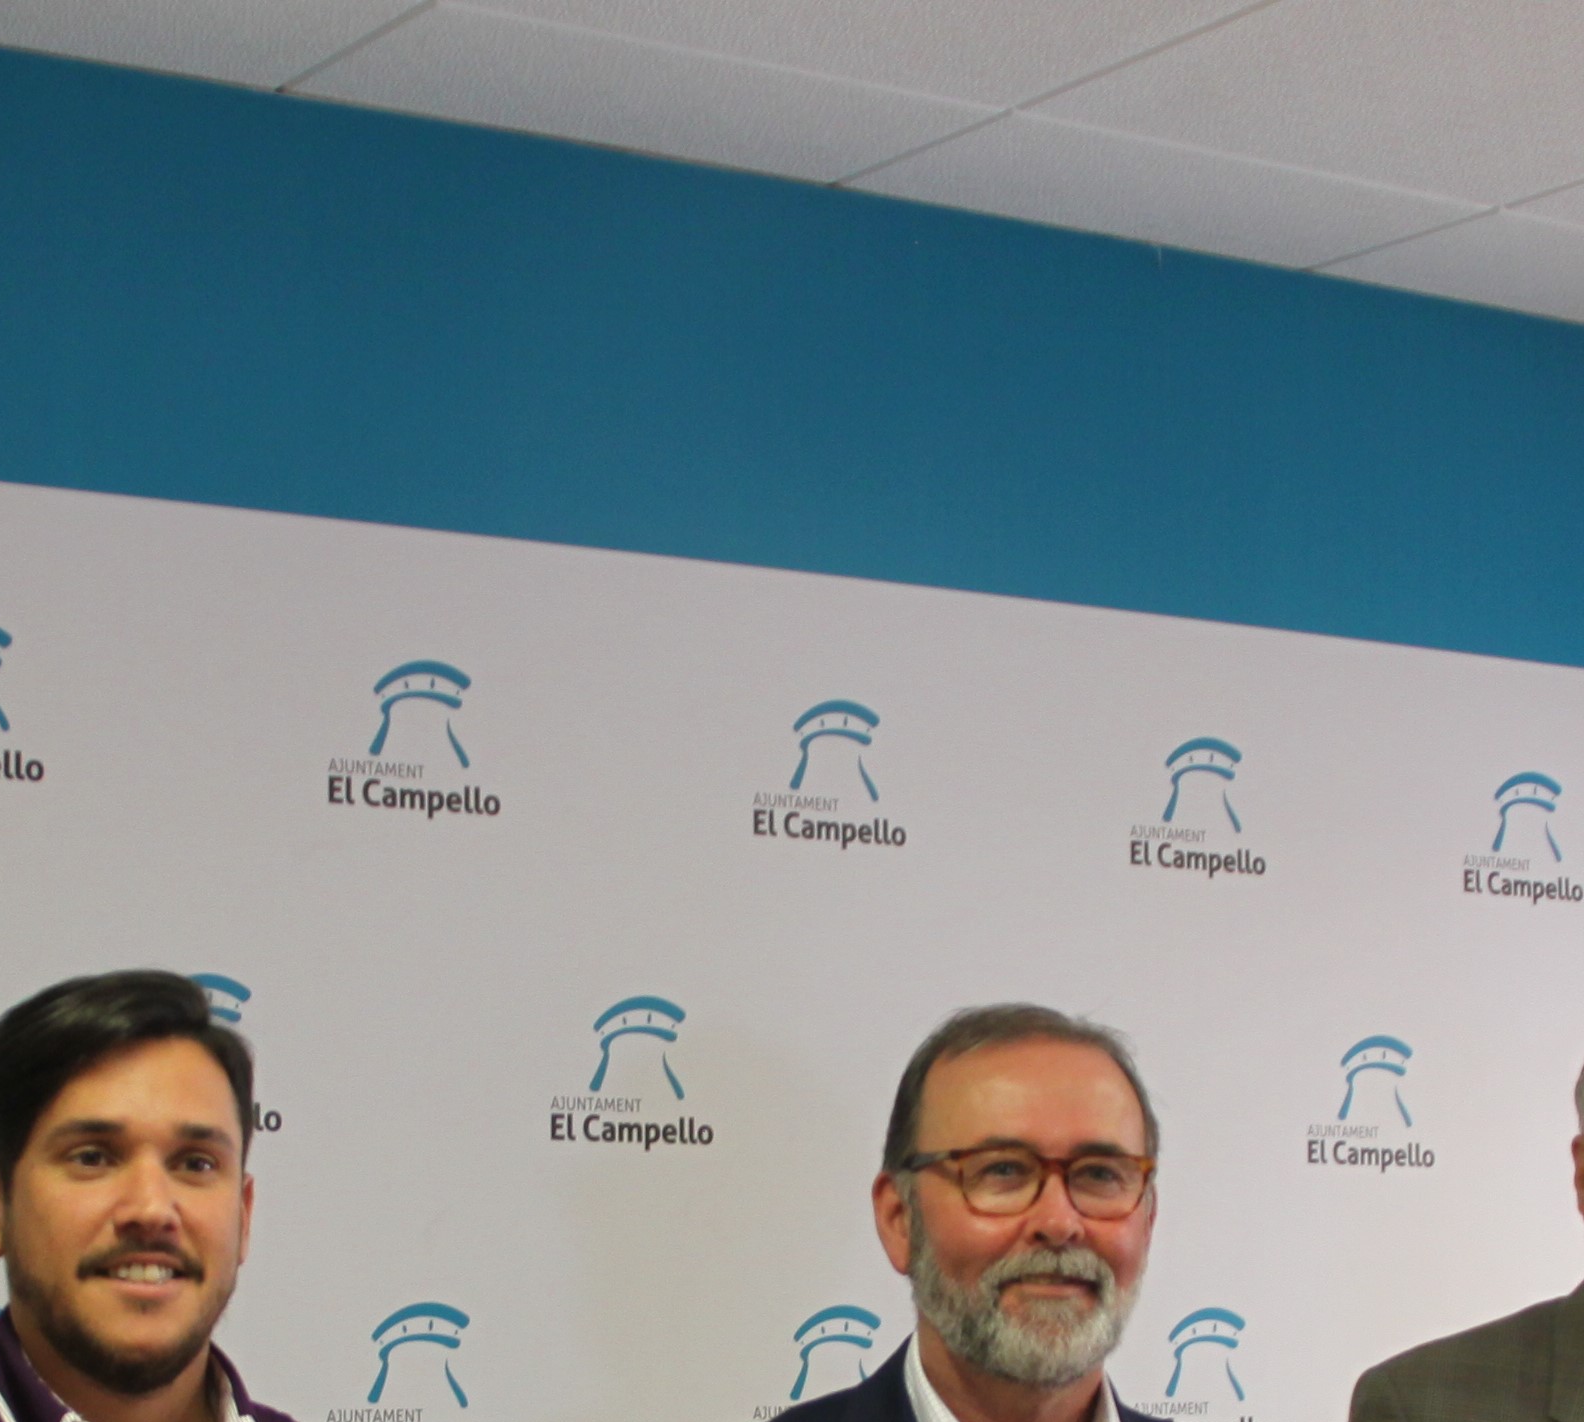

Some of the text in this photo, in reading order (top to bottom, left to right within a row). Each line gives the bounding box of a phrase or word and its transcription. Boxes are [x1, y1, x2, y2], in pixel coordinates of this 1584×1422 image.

[328, 758, 424, 781] AJUNTAMENT
[327, 776, 501, 819] El Campello
[753, 791, 840, 813] AJUNTAMENT
[753, 809, 907, 850] El Campello
[1129, 825, 1206, 844] AJUNTAMENT
[1129, 841, 1266, 879] El Campello
[1463, 854, 1531, 872] AJUNTAMENT
[1463, 871, 1584, 905] El Campello
[551, 1096, 642, 1113] AJUNTAMENT
[550, 1114, 714, 1151] El Campello
[1306, 1125, 1379, 1139] AJUNTAMENT
[1306, 1140, 1435, 1172] El Campello
